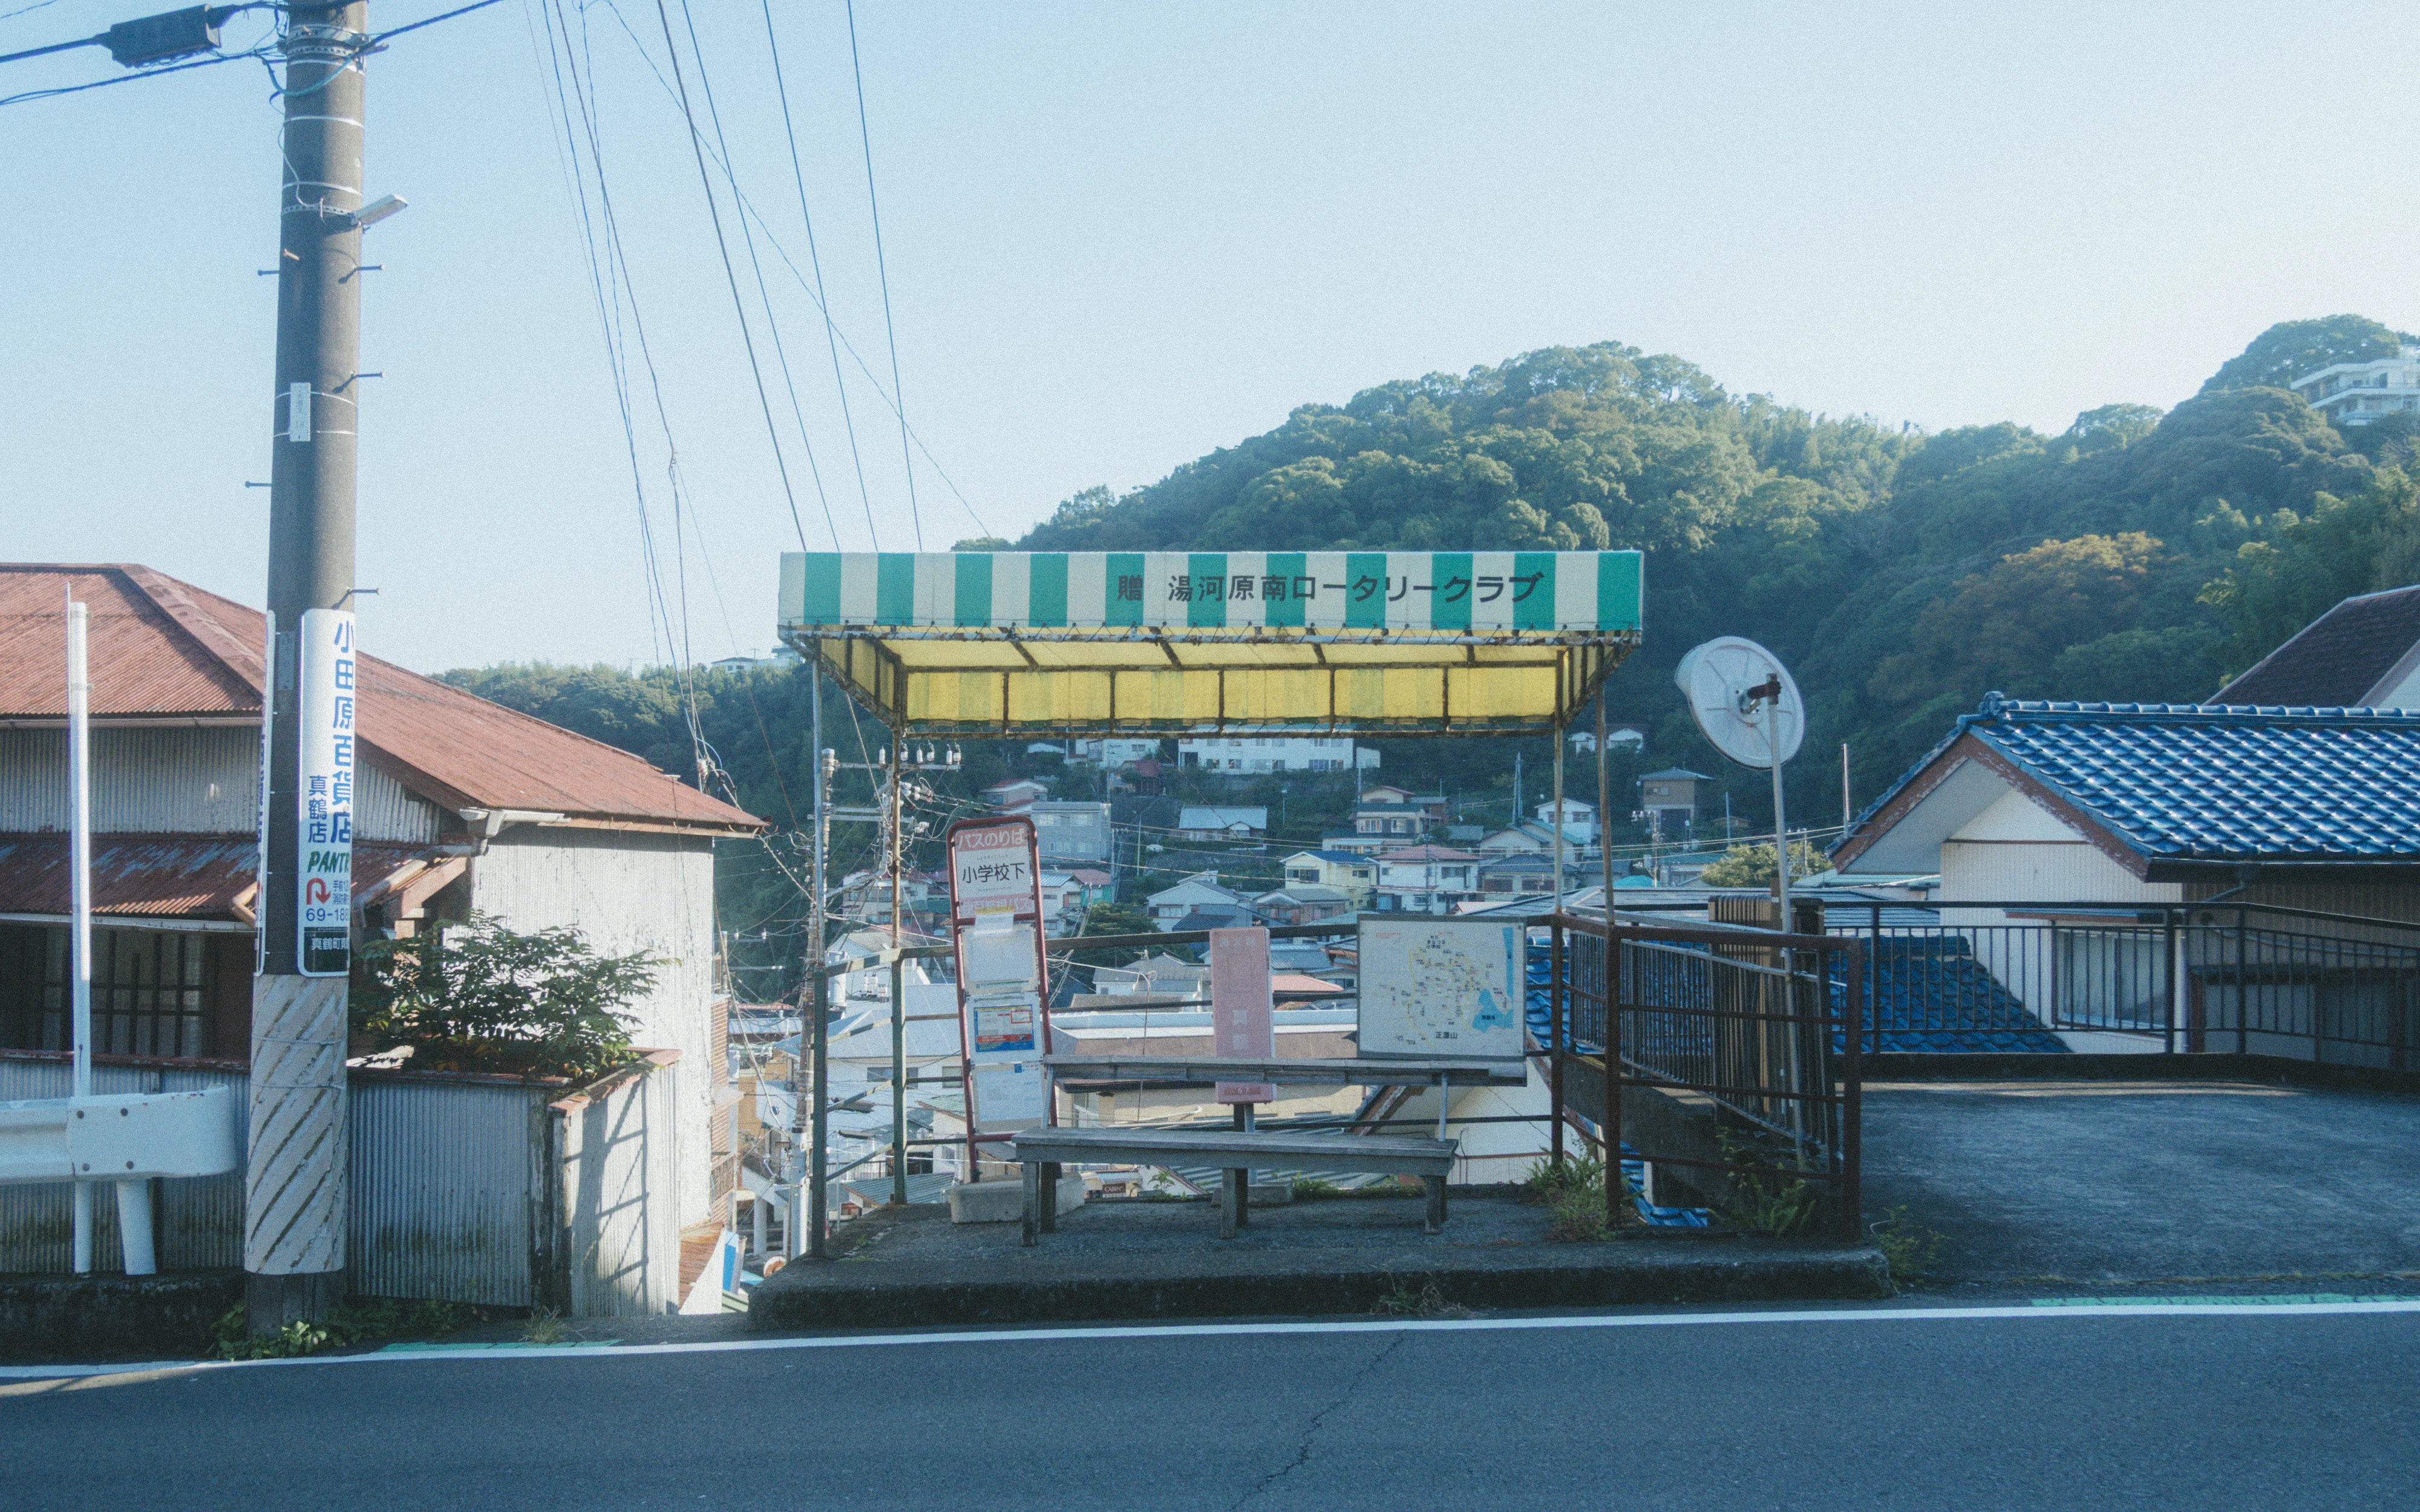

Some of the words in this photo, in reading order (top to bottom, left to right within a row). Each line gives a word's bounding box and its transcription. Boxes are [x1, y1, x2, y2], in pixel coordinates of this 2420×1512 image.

[1117, 573, 1144, 602] 贈
[1168, 571, 1545, 603] 湯河原南ロータリークラブ
[330, 619, 355, 844] 小田原百貨店
[308, 775, 328, 844] 真鶴店
[958, 828, 1025, 849] バスのりば
[962, 862, 1025, 884] 小学校下
